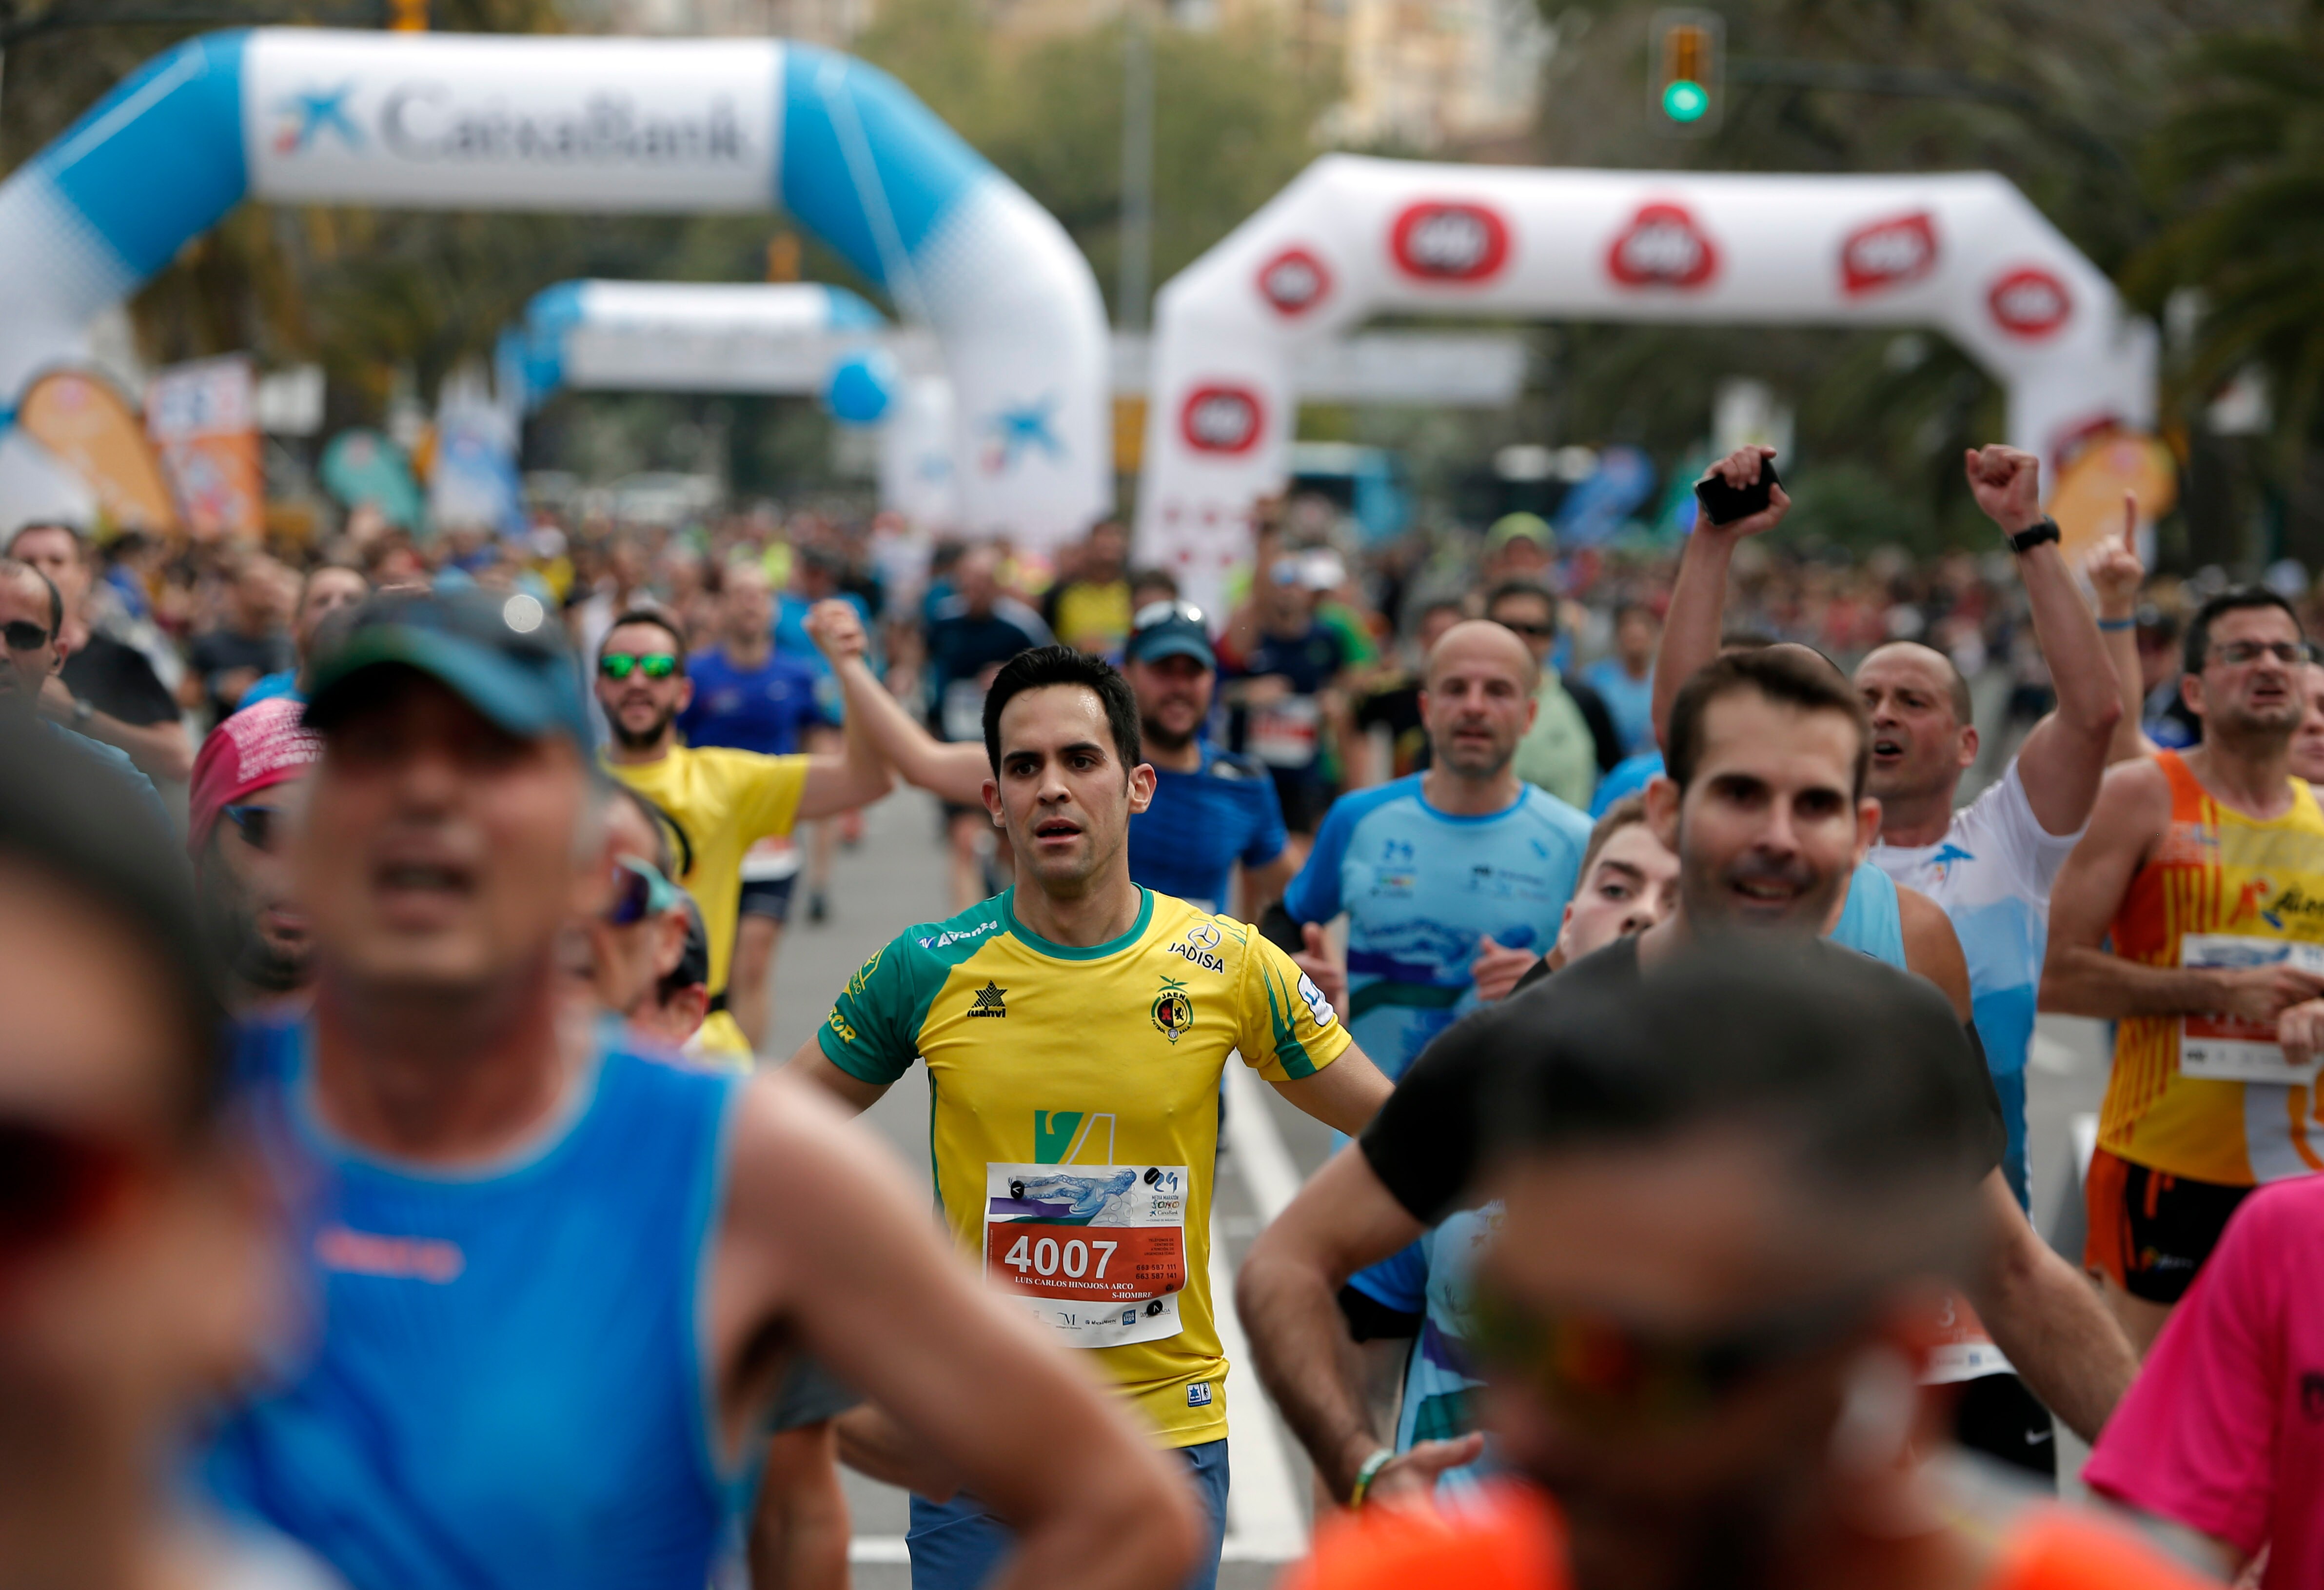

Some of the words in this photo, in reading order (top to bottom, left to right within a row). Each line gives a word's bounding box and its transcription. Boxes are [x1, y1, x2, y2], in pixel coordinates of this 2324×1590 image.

[937, 920, 998, 948] Avanza
[1167, 943, 1223, 974] JADISA
[1162, 992, 1186, 1000] JAEN
[1151, 1019, 1166, 1034] FUTBOL
[1179, 1025, 1191, 1034] SALA
[1004, 1235, 1118, 1279] 4007
[1015, 1276, 1033, 1284] LUIS
[1034, 1279, 1067, 1288] CARLOS
[1068, 1281, 1109, 1290] HINOJOSA
